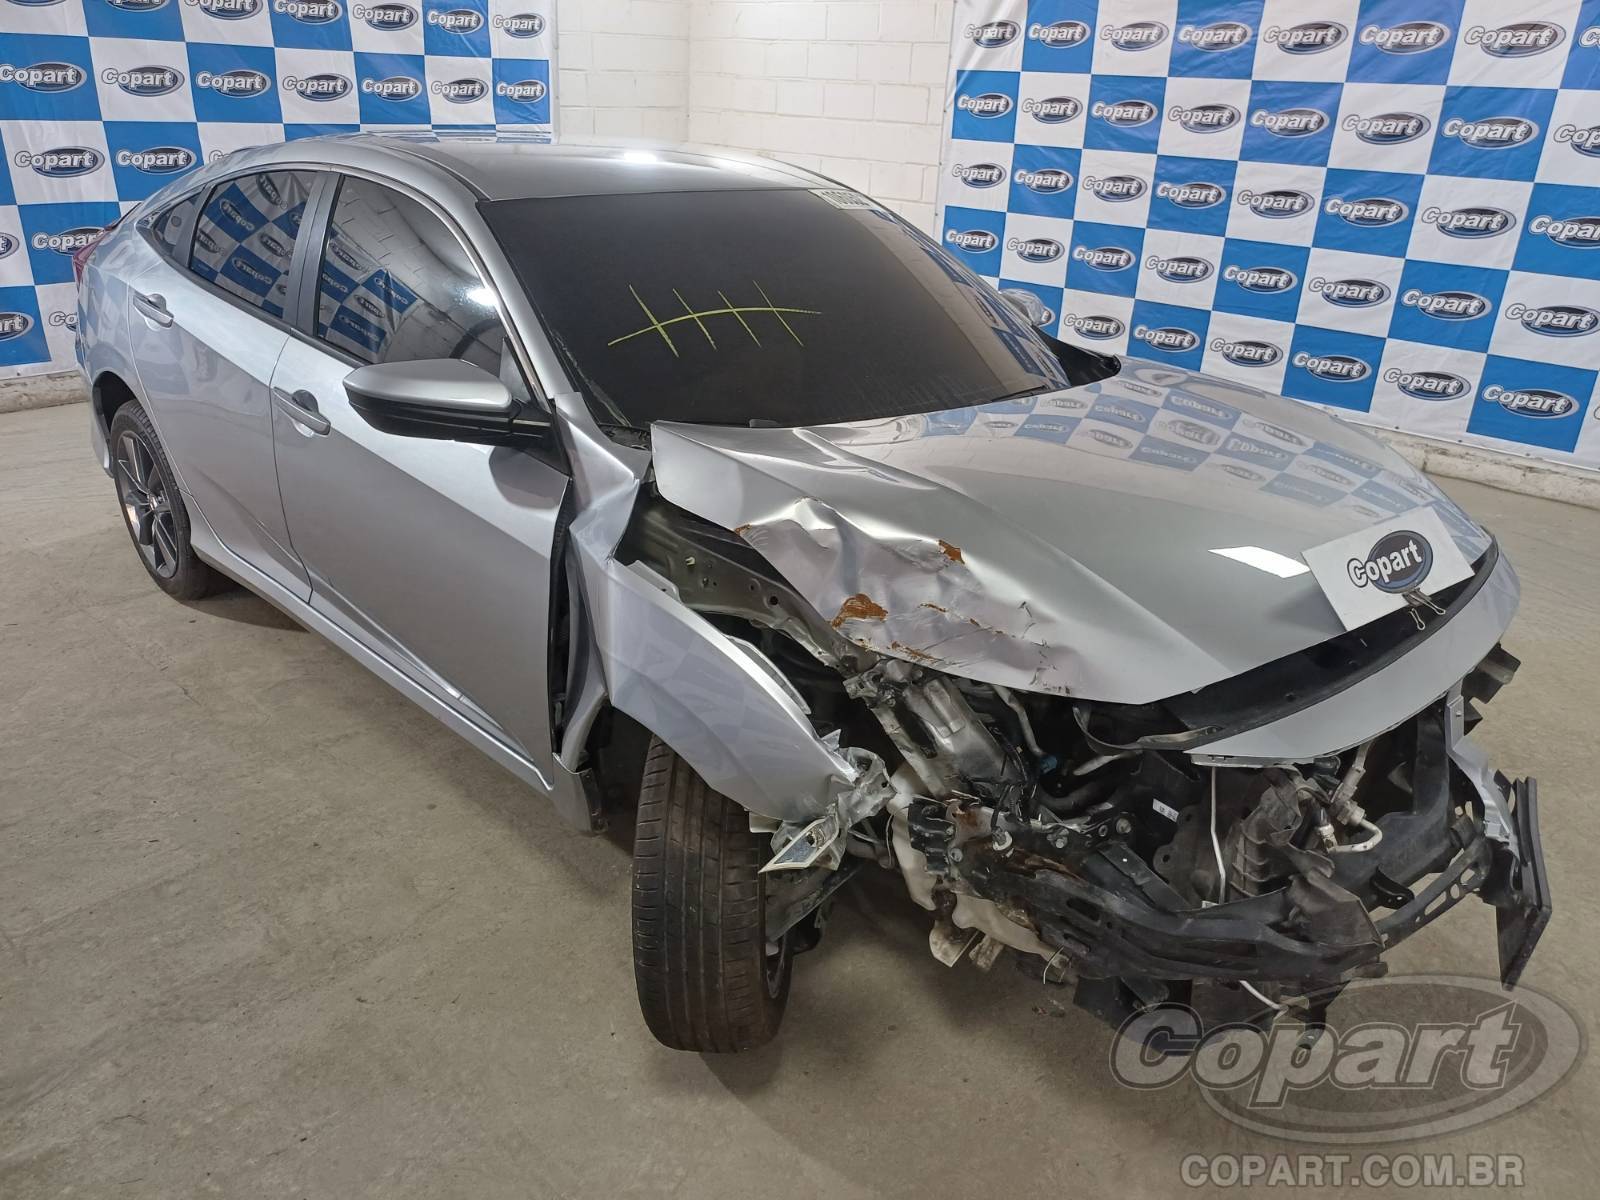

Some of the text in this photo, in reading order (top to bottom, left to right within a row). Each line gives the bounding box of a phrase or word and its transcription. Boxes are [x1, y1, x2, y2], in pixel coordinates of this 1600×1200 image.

[274, 0, 335, 18] Copart
[353, 5, 410, 23] Copart
[427, 9, 478, 28] Copart
[494, 15, 541, 30] Copart
[1028, 23, 1082, 42] Copart
[964, 24, 1013, 42] Copart
[1100, 25, 1159, 44] Copart
[1178, 25, 1242, 45] Copart
[1264, 26, 1341, 48] Copart
[1359, 25, 1440, 48] Copart
[1464, 26, 1553, 49] Copart
[0, 64, 77, 86] Copart
[102, 67, 174, 88] Copart
[197, 71, 262, 90] Copart
[283, 76, 344, 95] Copart
[362, 79, 416, 96] Copart
[432, 81, 482, 98] Copart
[497, 83, 542, 97] Copart
[957, 95, 1006, 112] Copart
[1022, 96, 1075, 116] Copart
[1092, 102, 1149, 120] Copart
[1168, 106, 1232, 125] Copart
[1251, 109, 1318, 130] Copart
[1342, 114, 1418, 136] Copart
[1442, 118, 1529, 142] Copart
[1554, 124, 1600, 149] Cop
[15, 151, 94, 169] Copart
[117, 150, 187, 168] Copart
[952, 164, 998, 180] Copart
[1014, 169, 1066, 187] Copart
[1082, 176, 1140, 195] Copart
[1156, 182, 1219, 202] Copart
[1238, 190, 1304, 211] Copart
[1325, 198, 1402, 221] Copart
[1421, 207, 1506, 231] Copart
[946, 229, 993, 248] Copart
[1007, 238, 1057, 257] Copart
[1072, 246, 1128, 267] Copart
[1145, 256, 1205, 276] Copart
[1224, 265, 1289, 288] Copart
[1309, 277, 1379, 302] Copart
[1402, 289, 1483, 315] Copart
[1064, 314, 1116, 334] Copart
[1505, 303, 1595, 330] Copart
[1134, 325, 1193, 348] Copart
[1210, 338, 1273, 361] Copart
[1293, 351, 1362, 378] Copart
[1384, 368, 1461, 395] Copart
[1482, 384, 1569, 413] Copart
[1347, 539, 1422, 588] Copart
